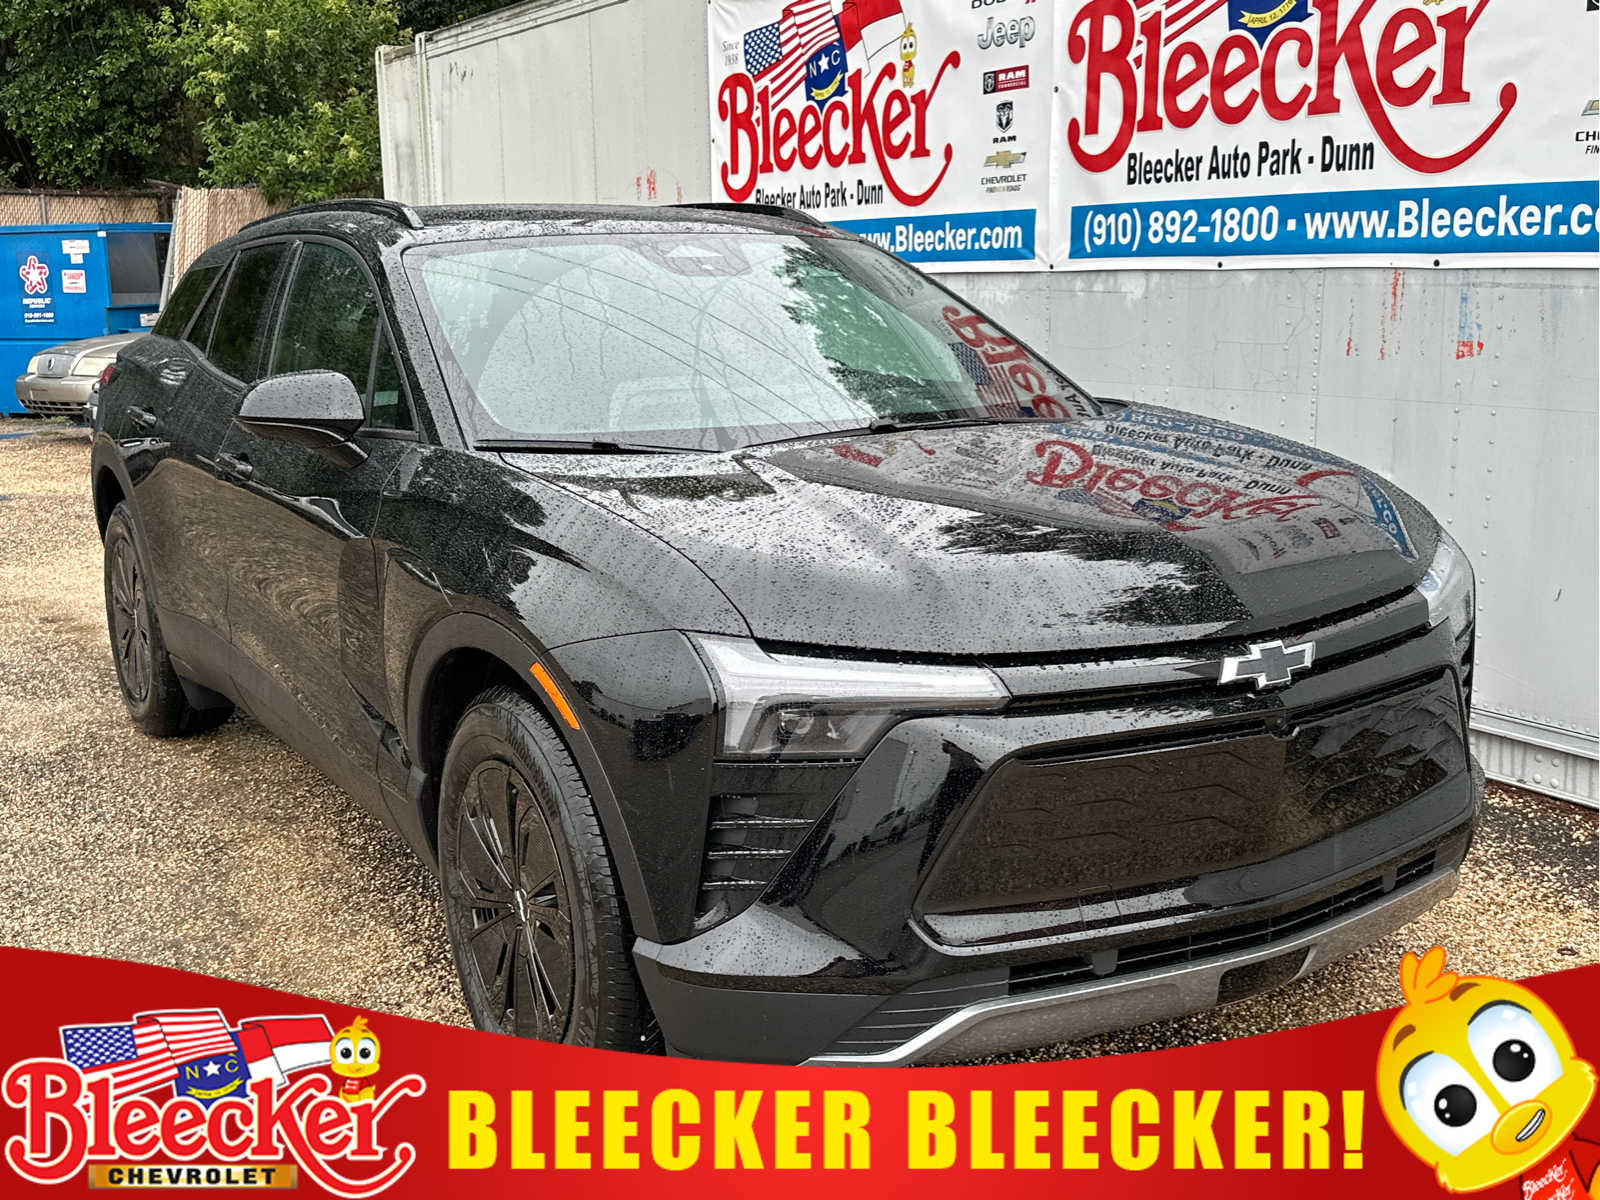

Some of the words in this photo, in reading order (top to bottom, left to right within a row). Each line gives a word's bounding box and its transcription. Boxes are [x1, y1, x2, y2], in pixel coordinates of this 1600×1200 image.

[977, 16, 1035, 49] Jeep
[998, 69, 1027, 82] RAM
[1067, 0, 1518, 174] Bleecker
[718, 51, 960, 206] Bleecker
[993, 135, 1017, 144] RAM
[1126, 147, 1203, 186] Bleecker
[1208, 145, 1251, 181] Auto
[1258, 138, 1301, 177] Park
[1321, 135, 1375, 173] Dunn
[755, 186, 797, 209] Bleecker
[800, 184, 822, 210] Auto
[825, 181, 848, 208] Park
[857, 179, 884, 205] Dunn
[981, 173, 1028, 185] CHEVROLET
[1083, 207, 1142, 253] (910)
[1147, 206, 1279, 244] 892-1800
[1304, 195, 1599, 241] www.Bleecker.c
